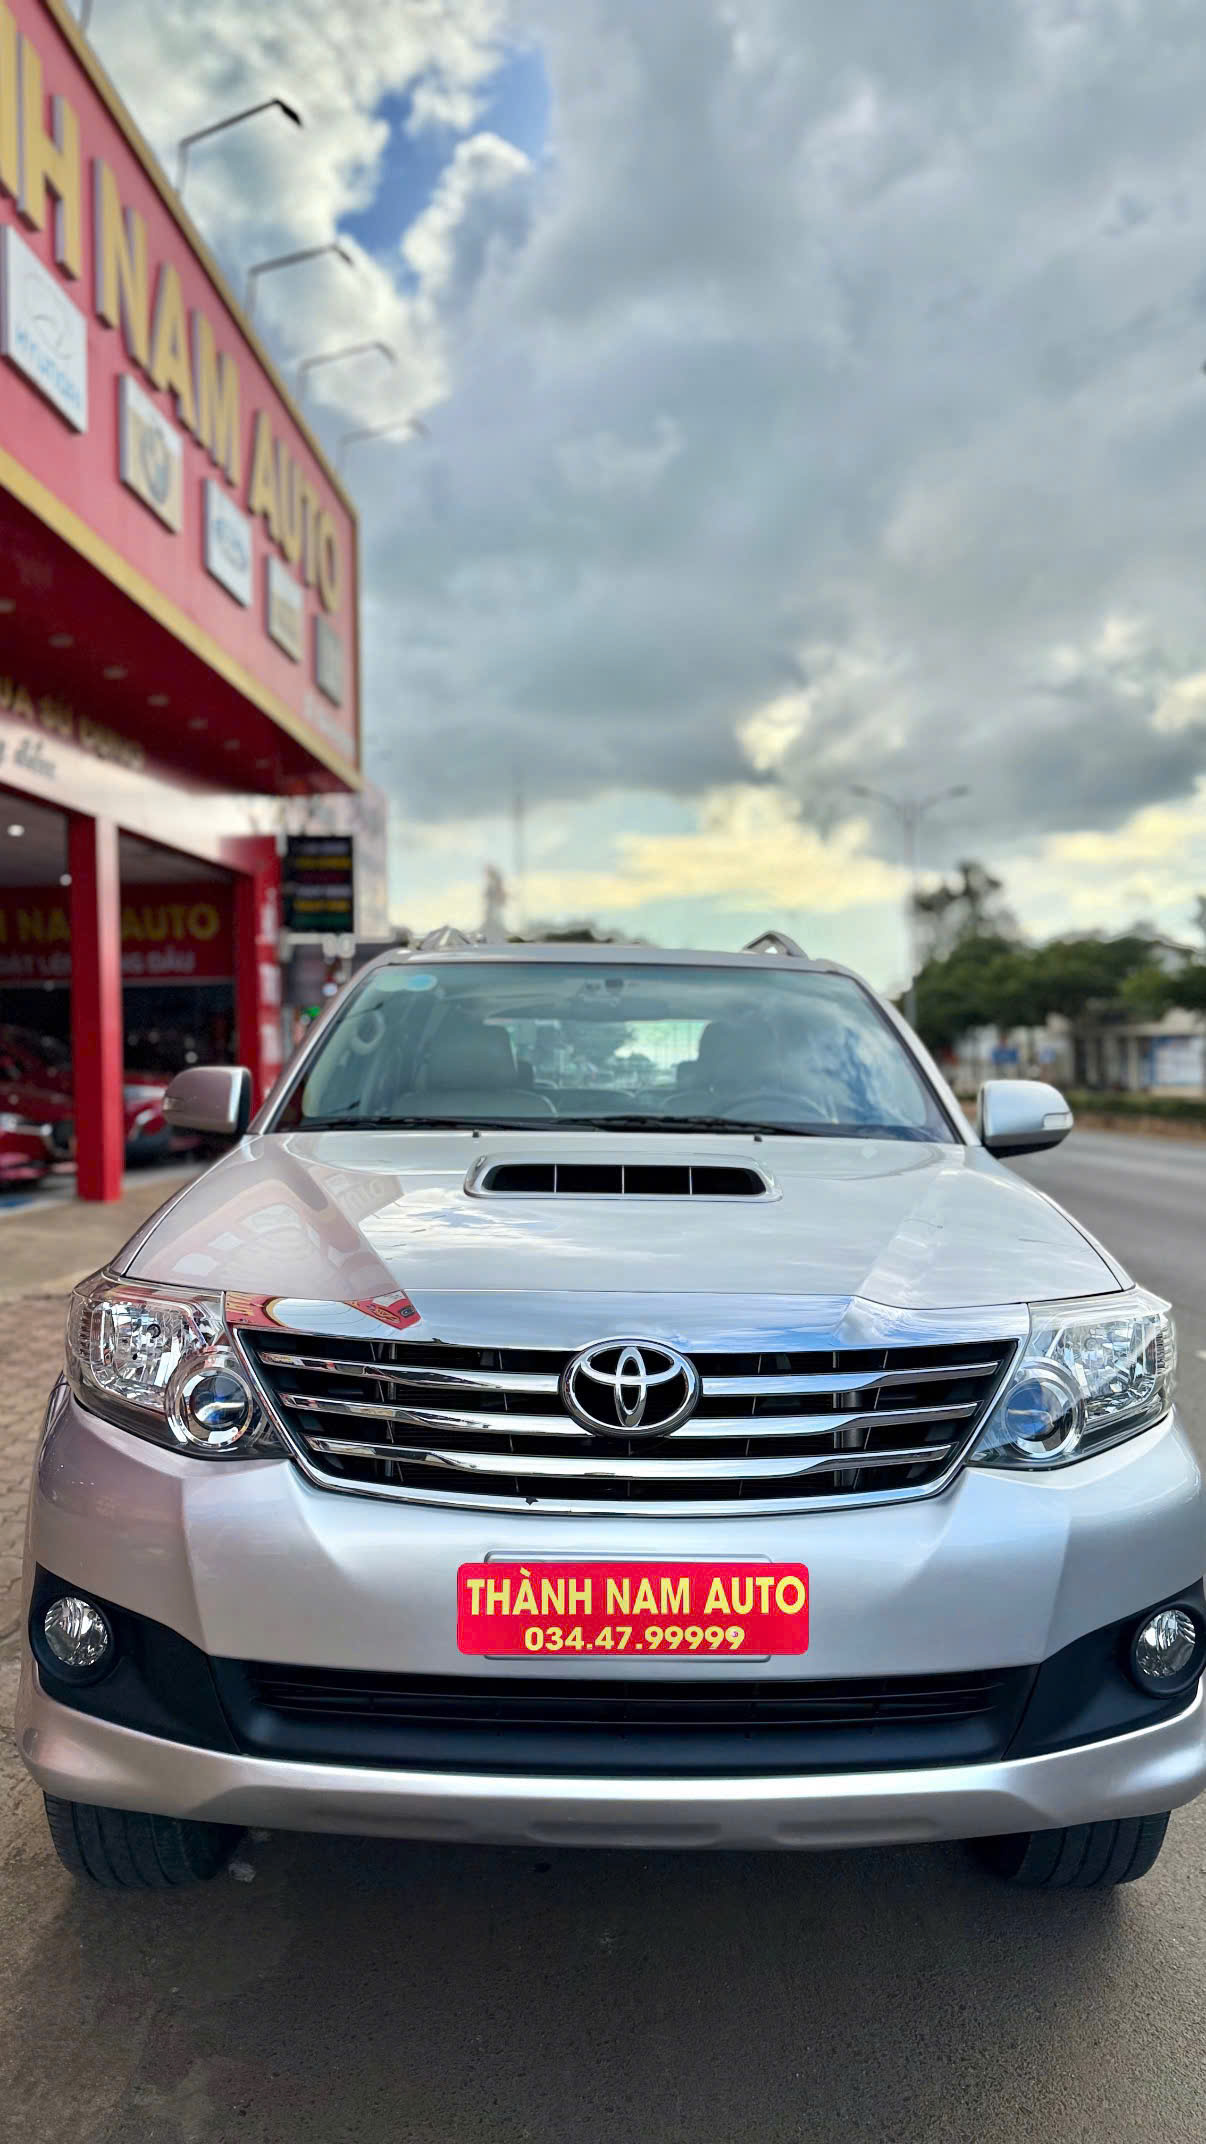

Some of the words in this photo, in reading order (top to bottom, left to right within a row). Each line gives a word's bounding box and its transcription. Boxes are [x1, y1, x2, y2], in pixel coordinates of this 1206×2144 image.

[93, 158, 240, 487] NAM
[248, 409, 342, 614] AUTO
[466, 1567, 592, 1616] THÀNH
[606, 1577, 690, 1615] NAM
[703, 1575, 806, 1615] AUTO
[523, 1625, 745, 1651] 034.47.99999
